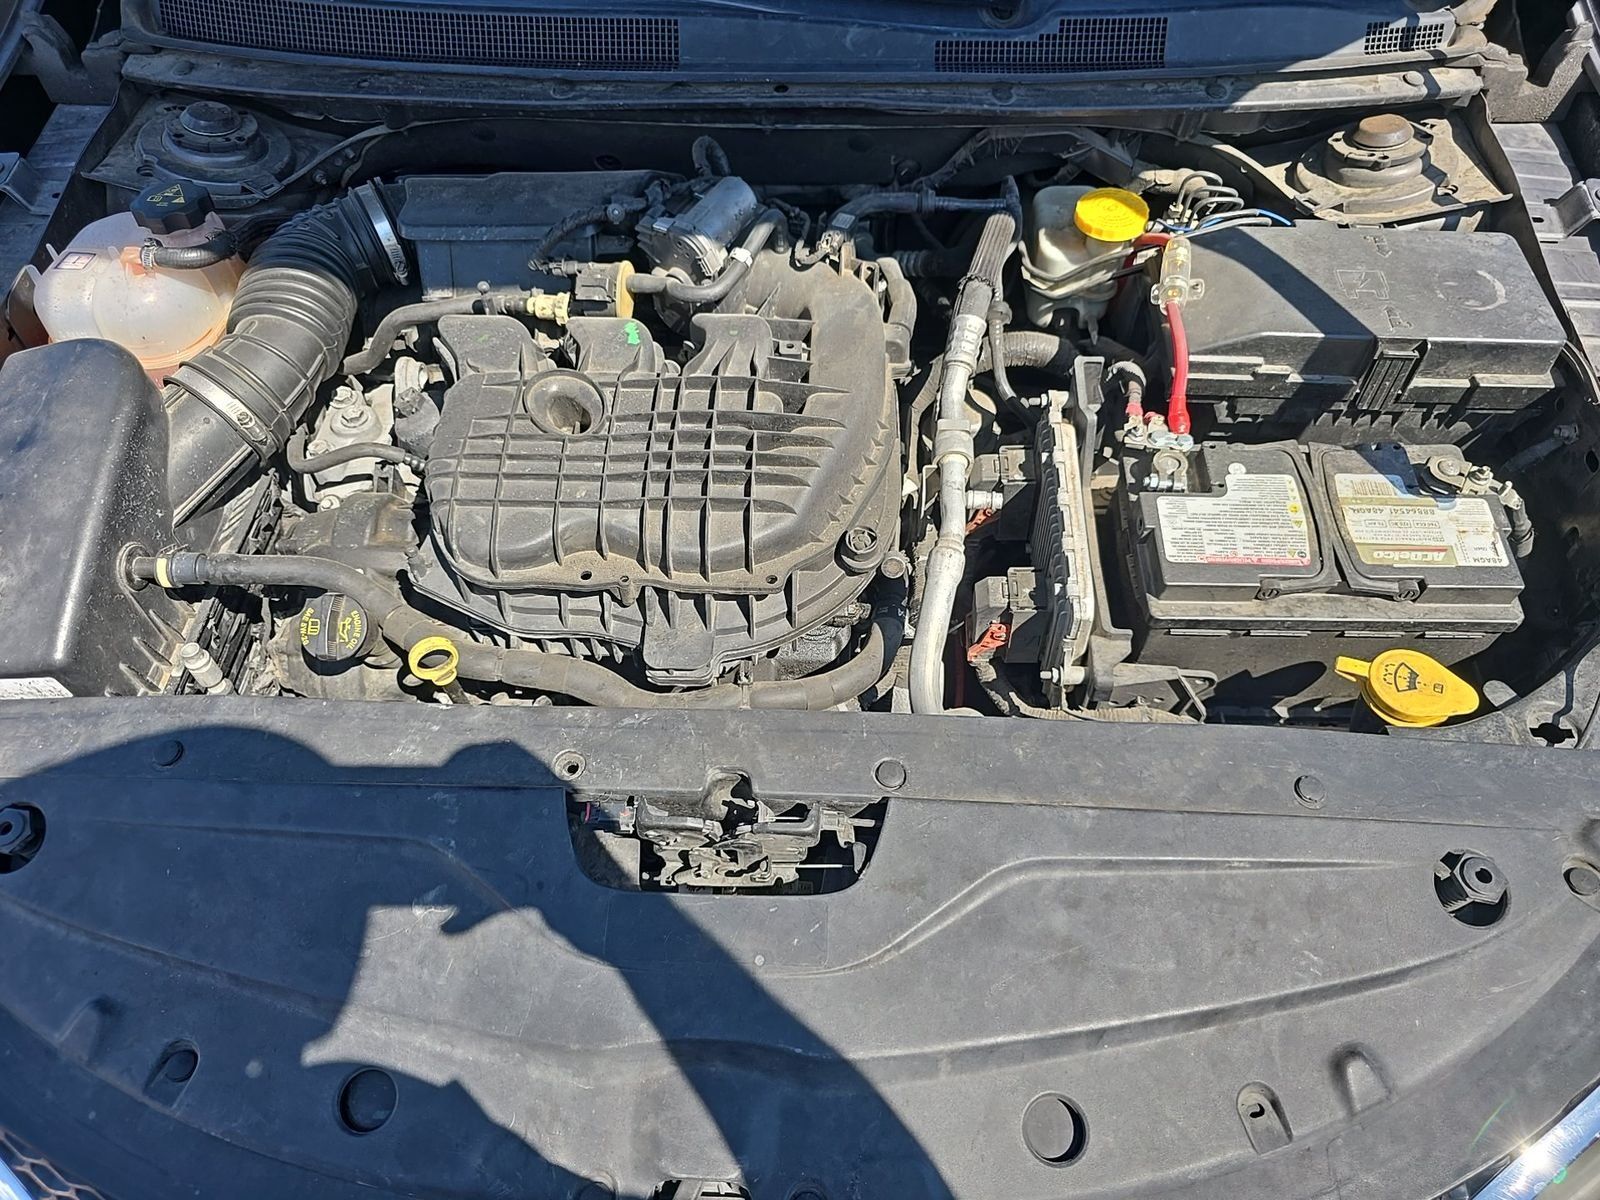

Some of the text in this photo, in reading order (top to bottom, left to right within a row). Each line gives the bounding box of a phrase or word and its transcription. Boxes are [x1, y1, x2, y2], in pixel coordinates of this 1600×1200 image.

[1373, 551, 1447, 561] ACDelco
[302, 607, 314, 622] SAE
[346, 610, 362, 650] ENGINE OIL
